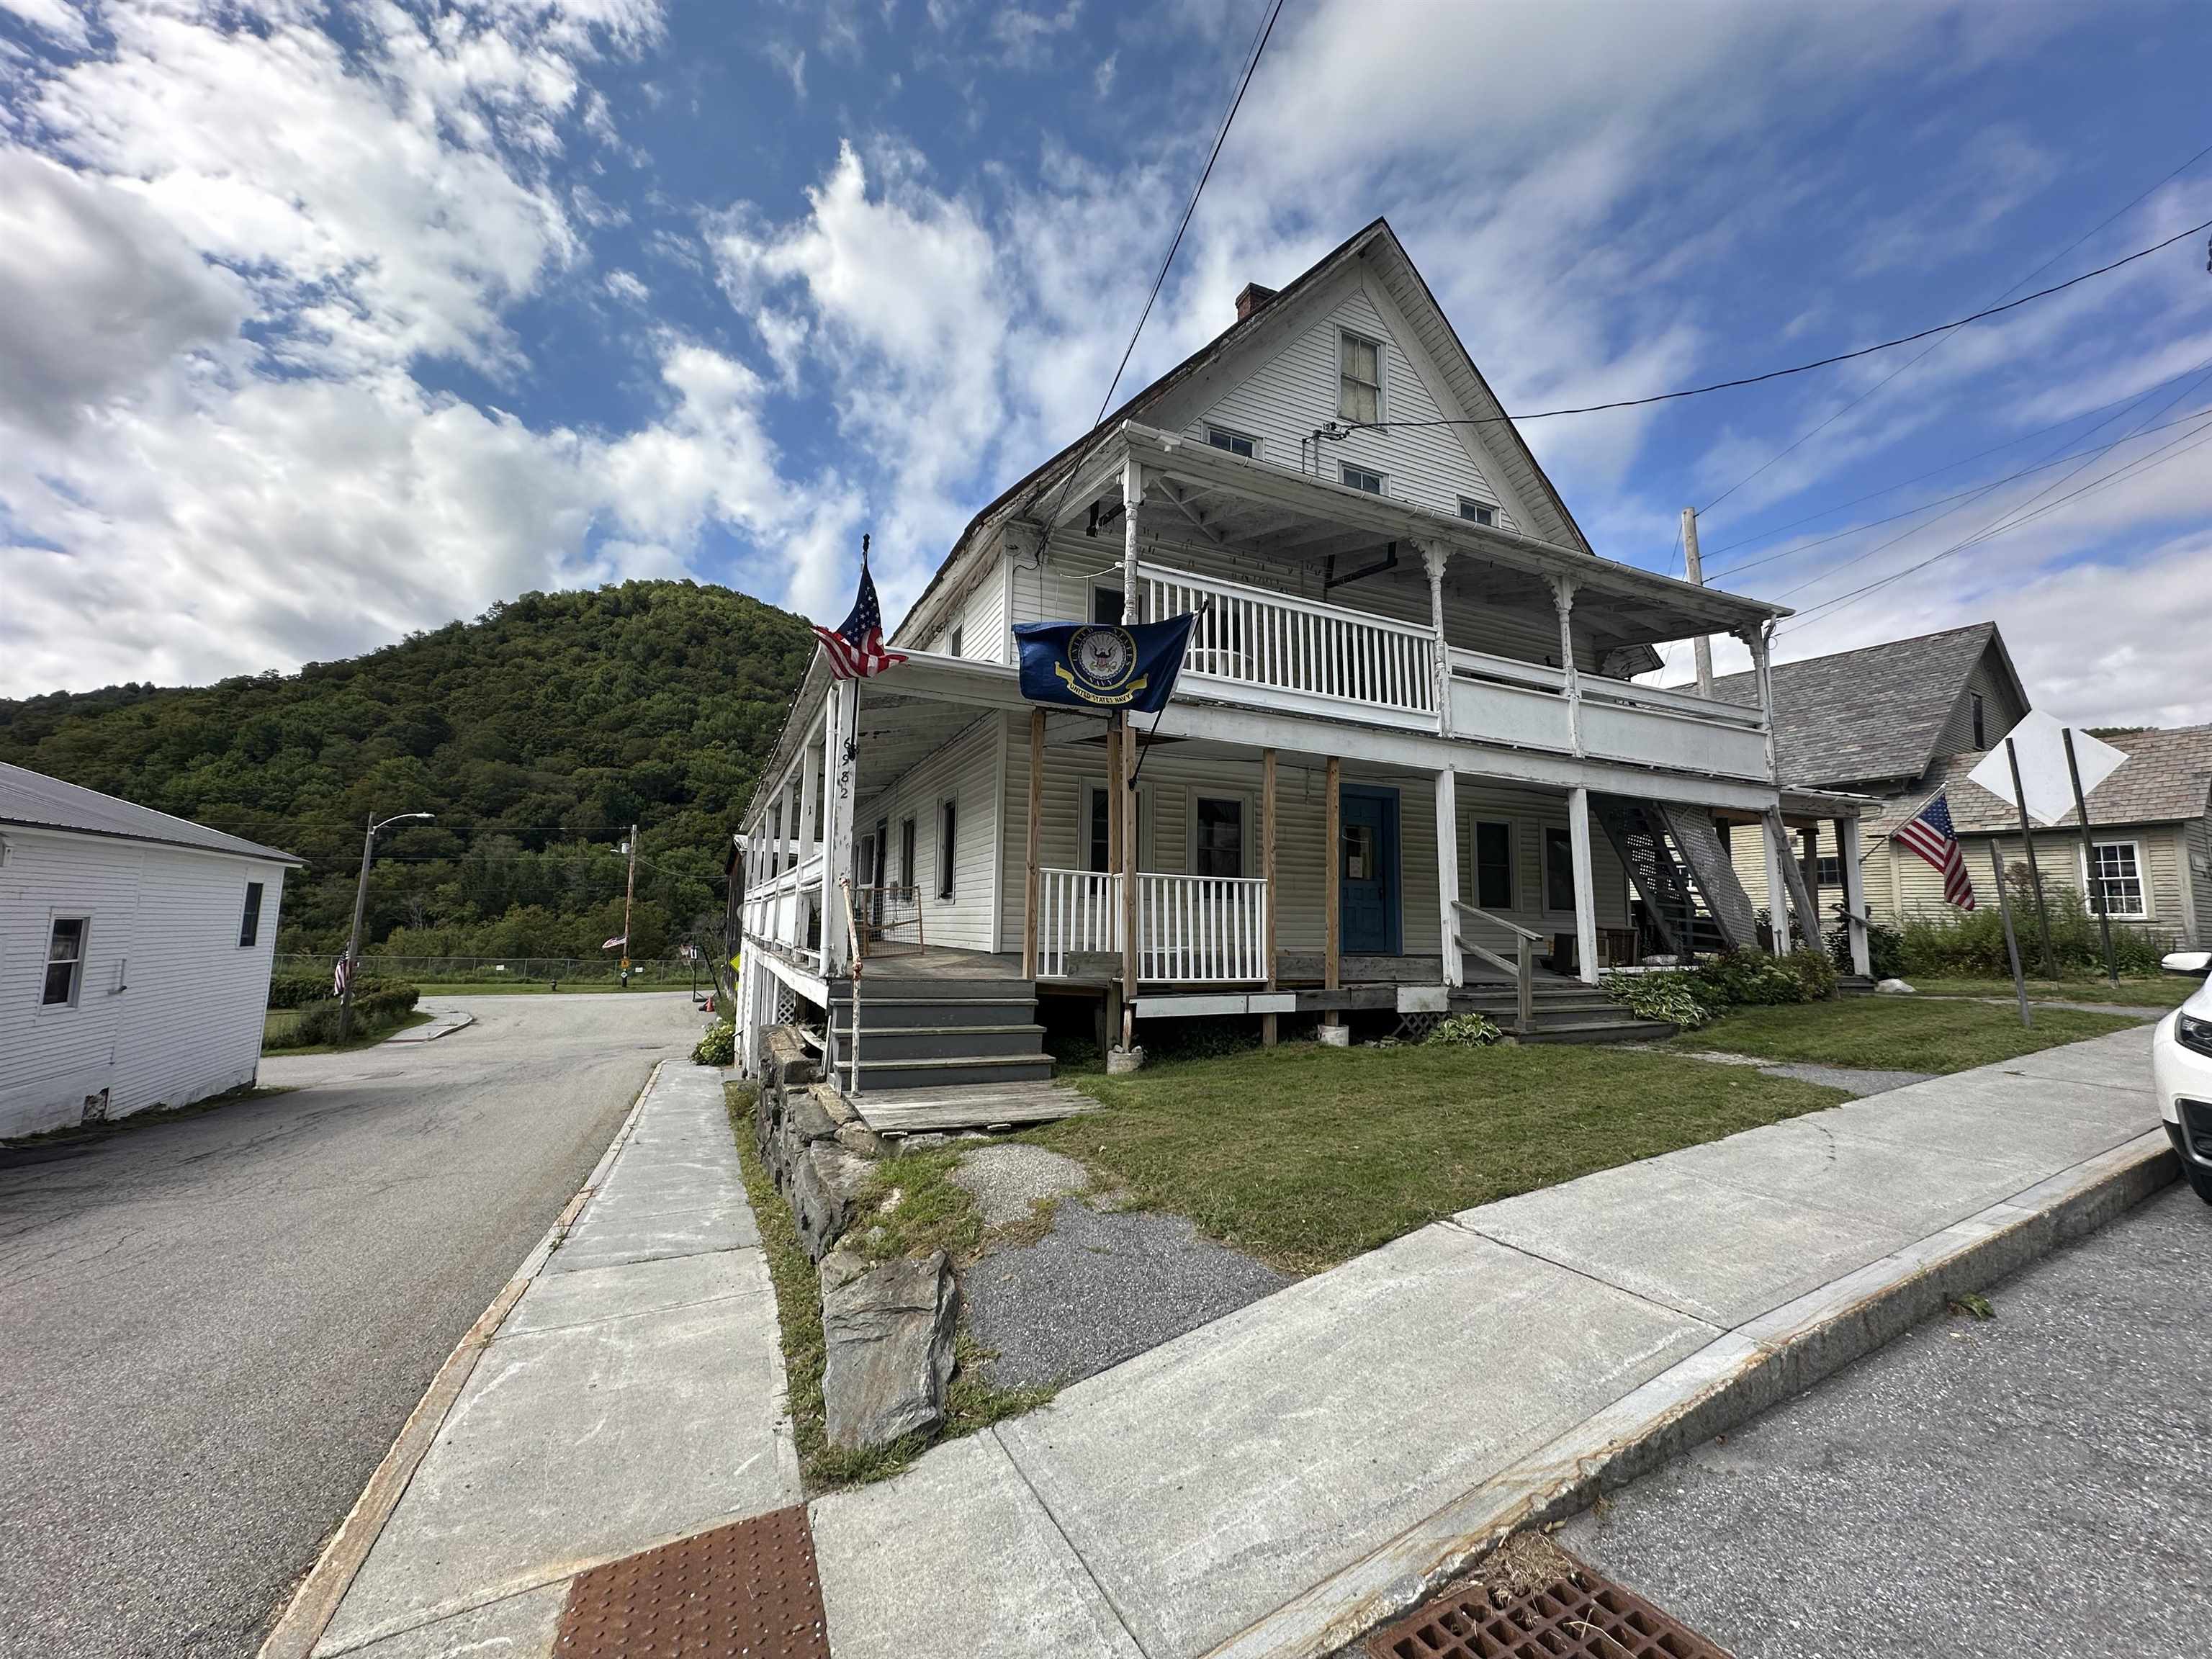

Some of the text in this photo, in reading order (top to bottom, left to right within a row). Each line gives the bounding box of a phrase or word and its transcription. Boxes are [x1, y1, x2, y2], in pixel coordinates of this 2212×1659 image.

[1072, 628, 1133, 666] UNITED STATES
[1089, 677, 1112, 685] NAVY
[1069, 683, 1091, 698] UNITED
[1115, 693, 1130, 703] NAVY
